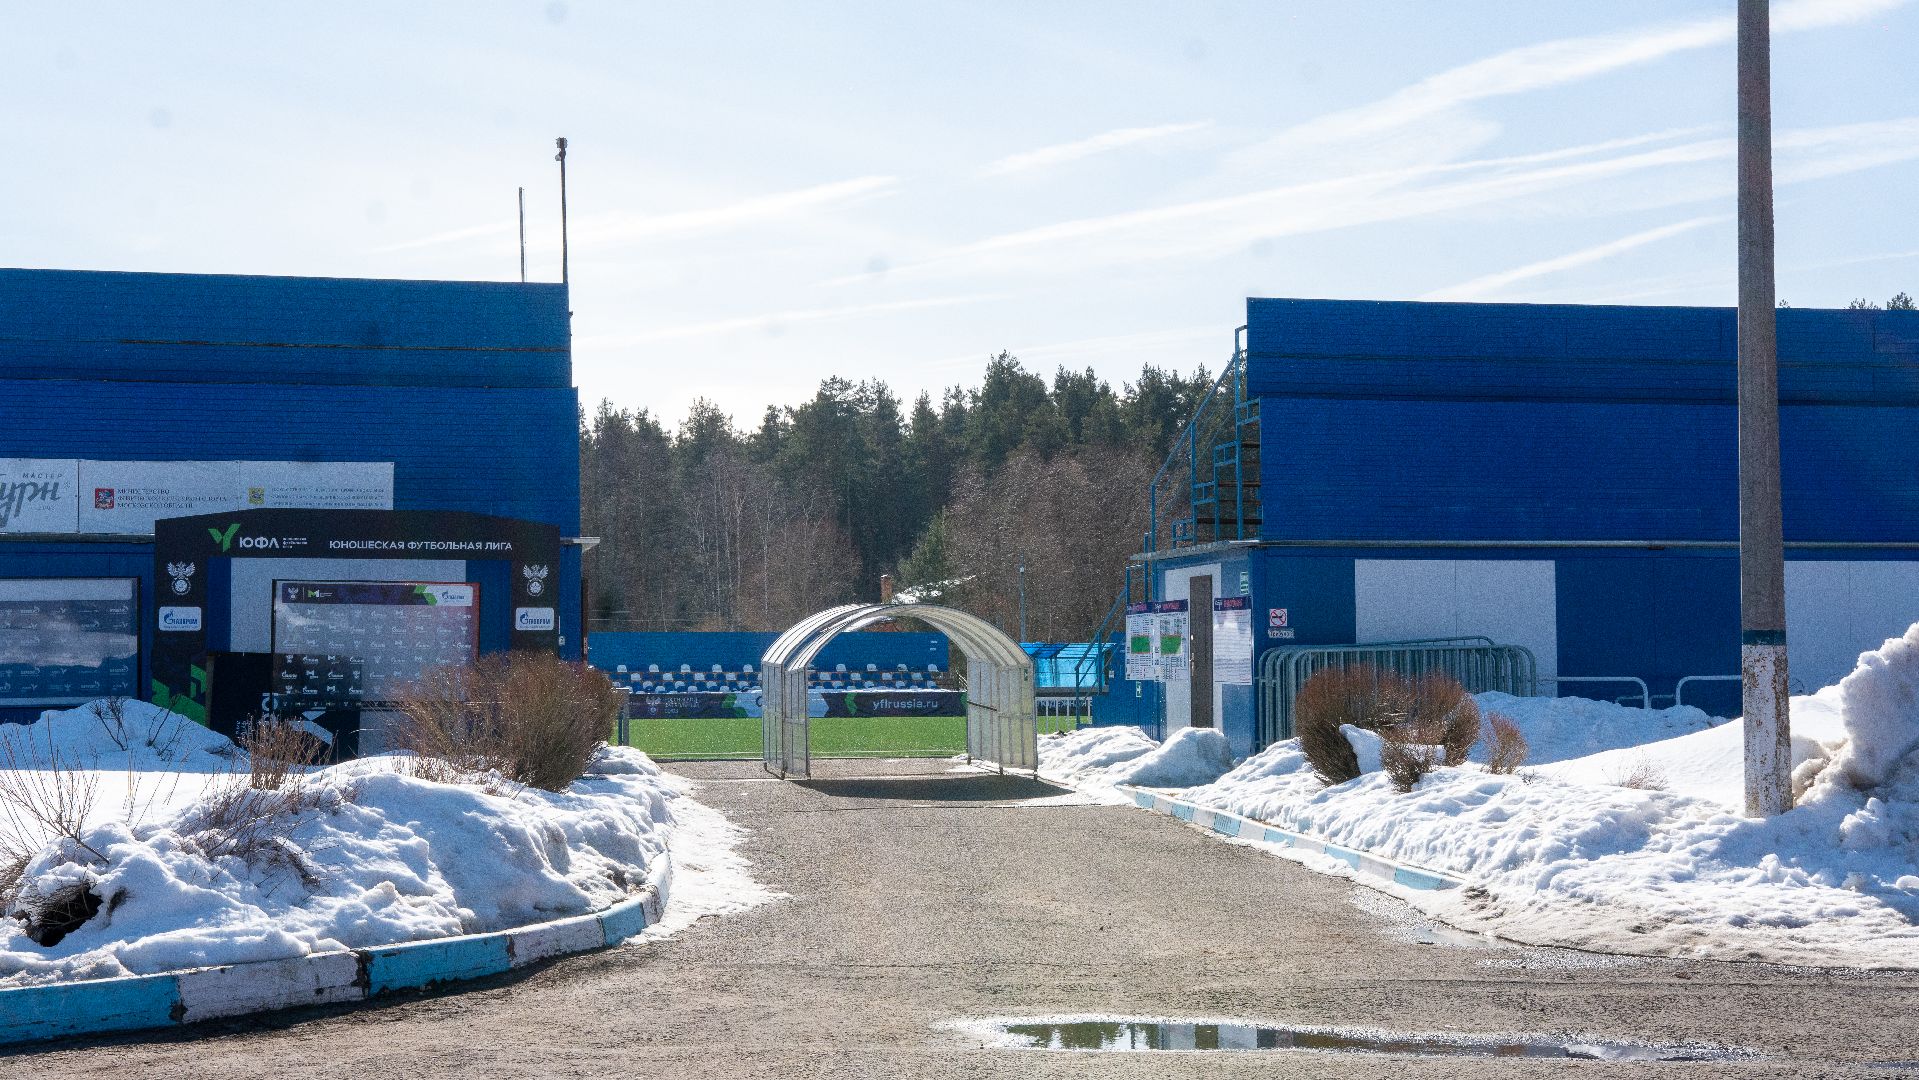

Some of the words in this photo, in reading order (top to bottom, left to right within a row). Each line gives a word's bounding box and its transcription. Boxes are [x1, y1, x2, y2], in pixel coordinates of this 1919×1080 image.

[0, 474, 61, 529] урн
[240, 536, 279, 549] ЮФЛ
[329, 540, 405, 550] ЮНОШЕСКАЯ
[407, 541, 483, 551] ФУТБОЛЬНАЯ
[484, 541, 513, 551] ЛИГА
[872, 698, 939, 711] yflrussia.ru
